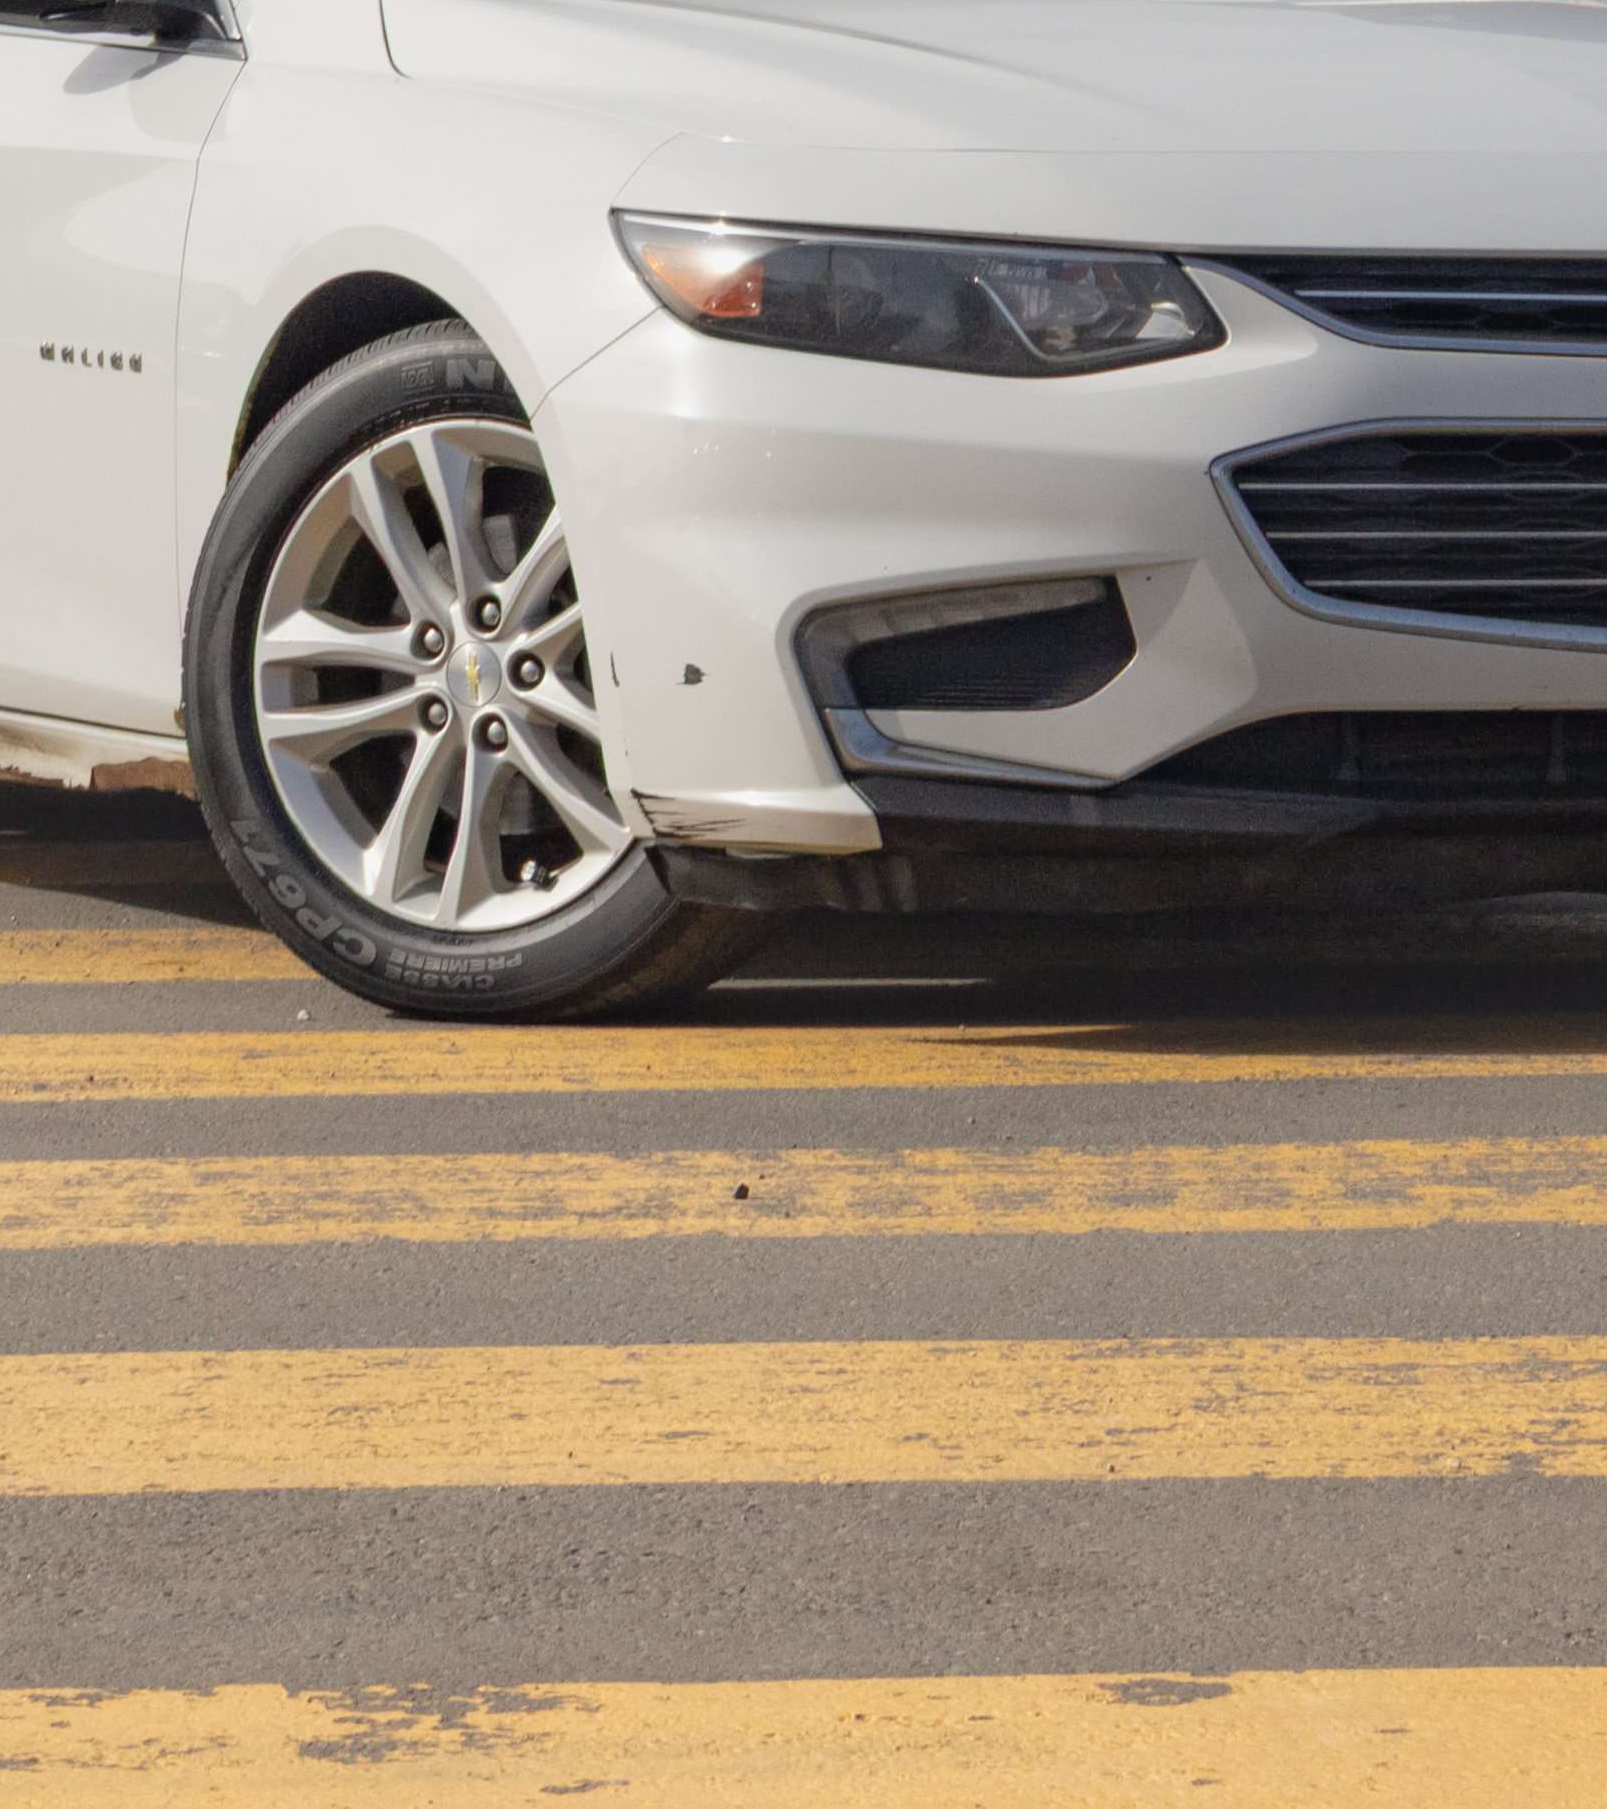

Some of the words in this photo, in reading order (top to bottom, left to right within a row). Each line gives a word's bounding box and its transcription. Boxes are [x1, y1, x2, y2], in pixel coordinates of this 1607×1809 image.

[230, 821, 377, 964] CP671
[388, 948, 523, 973] PREMIERE
[384, 964, 494, 989] CLASSE
